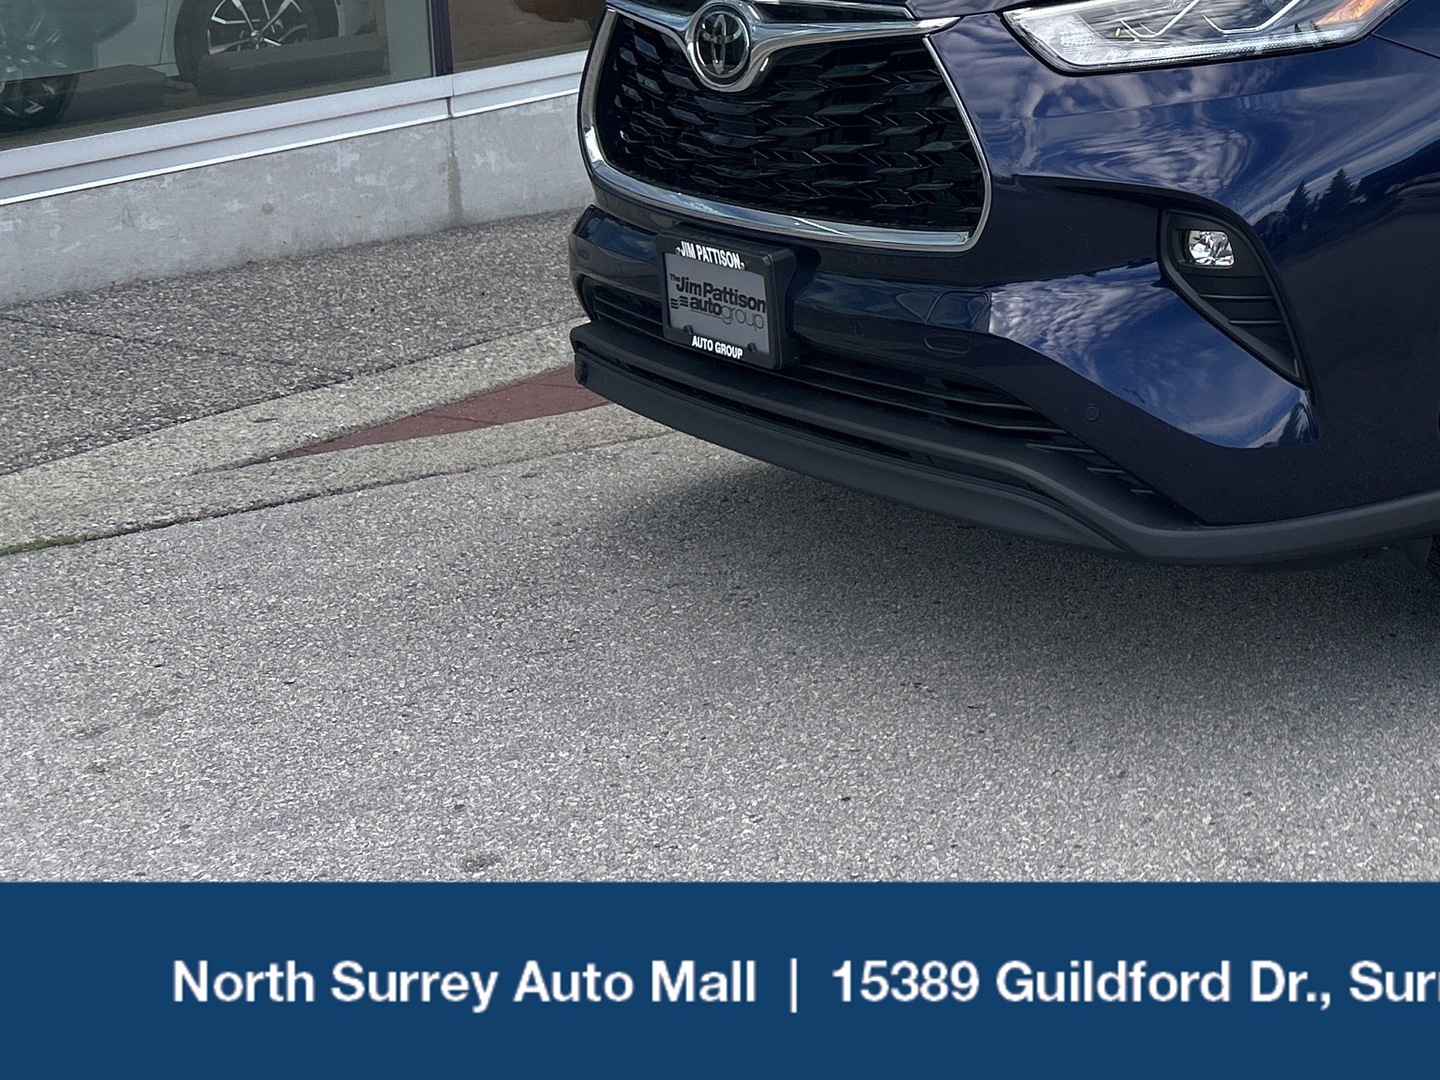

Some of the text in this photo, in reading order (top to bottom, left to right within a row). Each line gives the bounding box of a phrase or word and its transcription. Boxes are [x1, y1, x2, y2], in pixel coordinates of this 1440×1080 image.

[680, 240, 741, 270] JIM PATTISON
[669, 273, 681, 283] The
[692, 335, 744, 360] AUTO GROUP
